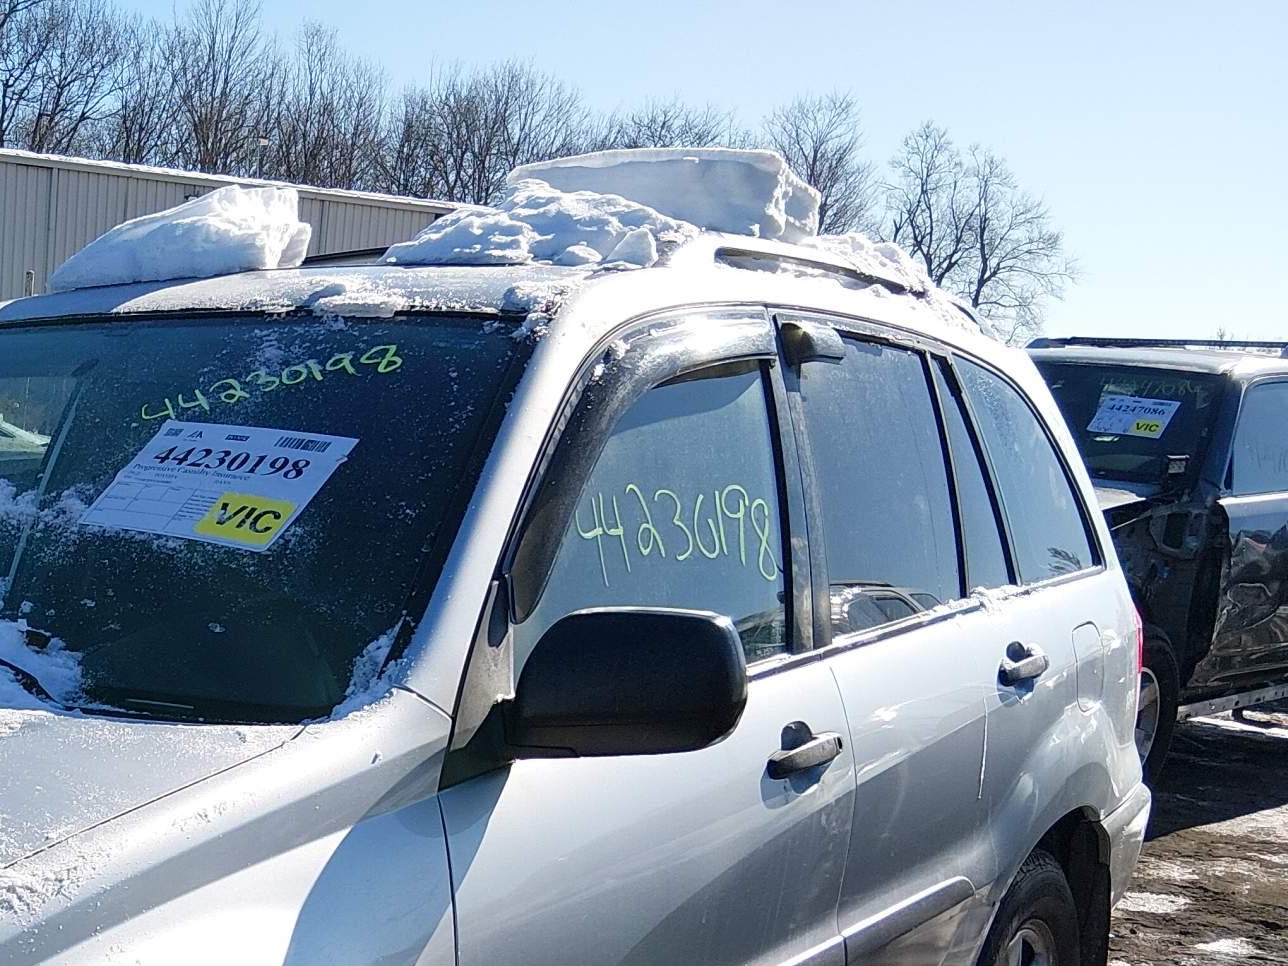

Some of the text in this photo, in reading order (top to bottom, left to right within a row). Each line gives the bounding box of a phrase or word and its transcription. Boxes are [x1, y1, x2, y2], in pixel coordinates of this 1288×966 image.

[141, 344, 402, 421] 44230198
[1136, 422, 1159, 432] VIC
[153, 445, 310, 480] 44230198
[216, 502, 281, 533] VIC
[575, 484, 778, 586] 44230198
